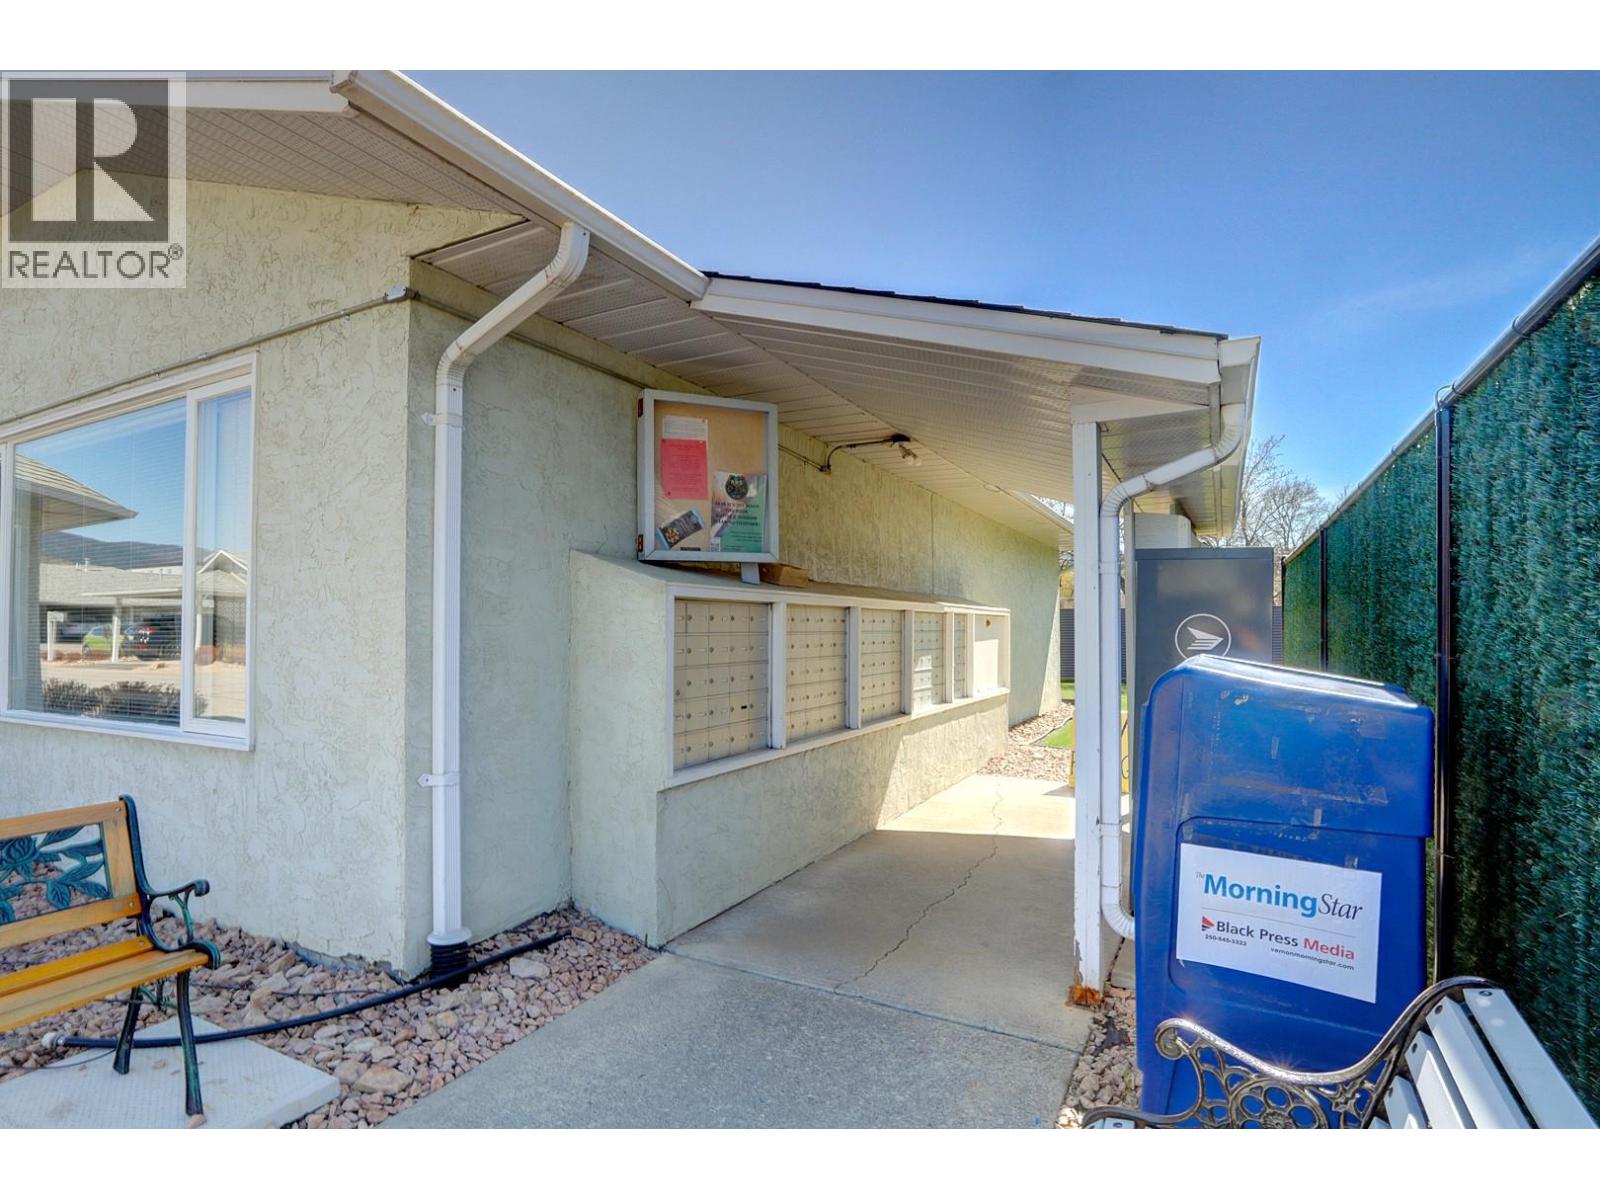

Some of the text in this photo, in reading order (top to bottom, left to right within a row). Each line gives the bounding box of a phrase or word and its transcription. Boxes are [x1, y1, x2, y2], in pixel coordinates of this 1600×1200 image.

[1217, 920, 1355, 960] Black Press Media
